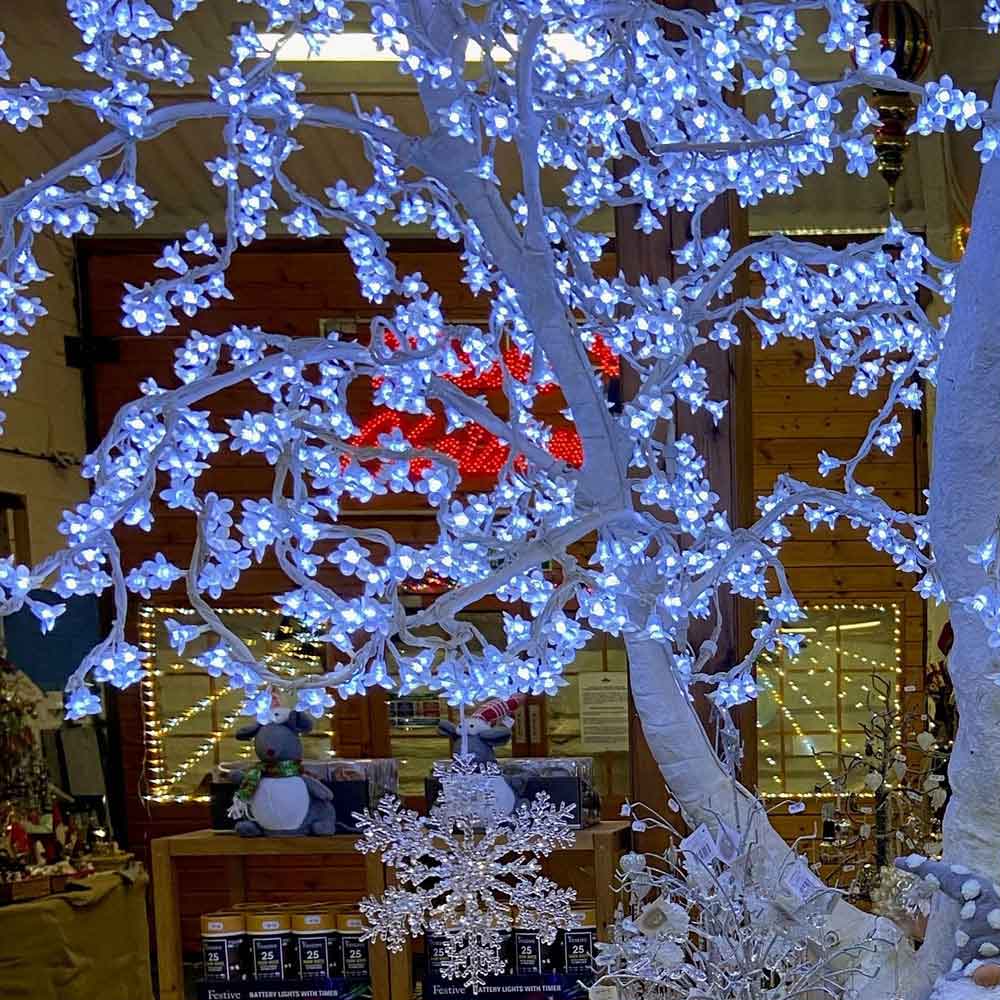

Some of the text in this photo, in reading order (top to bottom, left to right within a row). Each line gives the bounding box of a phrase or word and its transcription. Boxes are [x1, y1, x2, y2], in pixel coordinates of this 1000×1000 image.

[350, 949, 363, 959] 25
[433, 948, 445, 957] 25
[521, 946, 533, 955] 25
[572, 945, 585, 954] 25
[208, 952, 220, 962] 25
[261, 951, 275, 960] 25
[306, 950, 320, 960] 25
[207, 989, 241, 1000] Festive
[249, 991, 277, 999] BATTERY
[301, 990, 318, 998] WITH
[433, 984, 466, 995] Festive
[474, 985, 501, 993] ATTERY
[501, 985, 523, 993] LIGHTS
